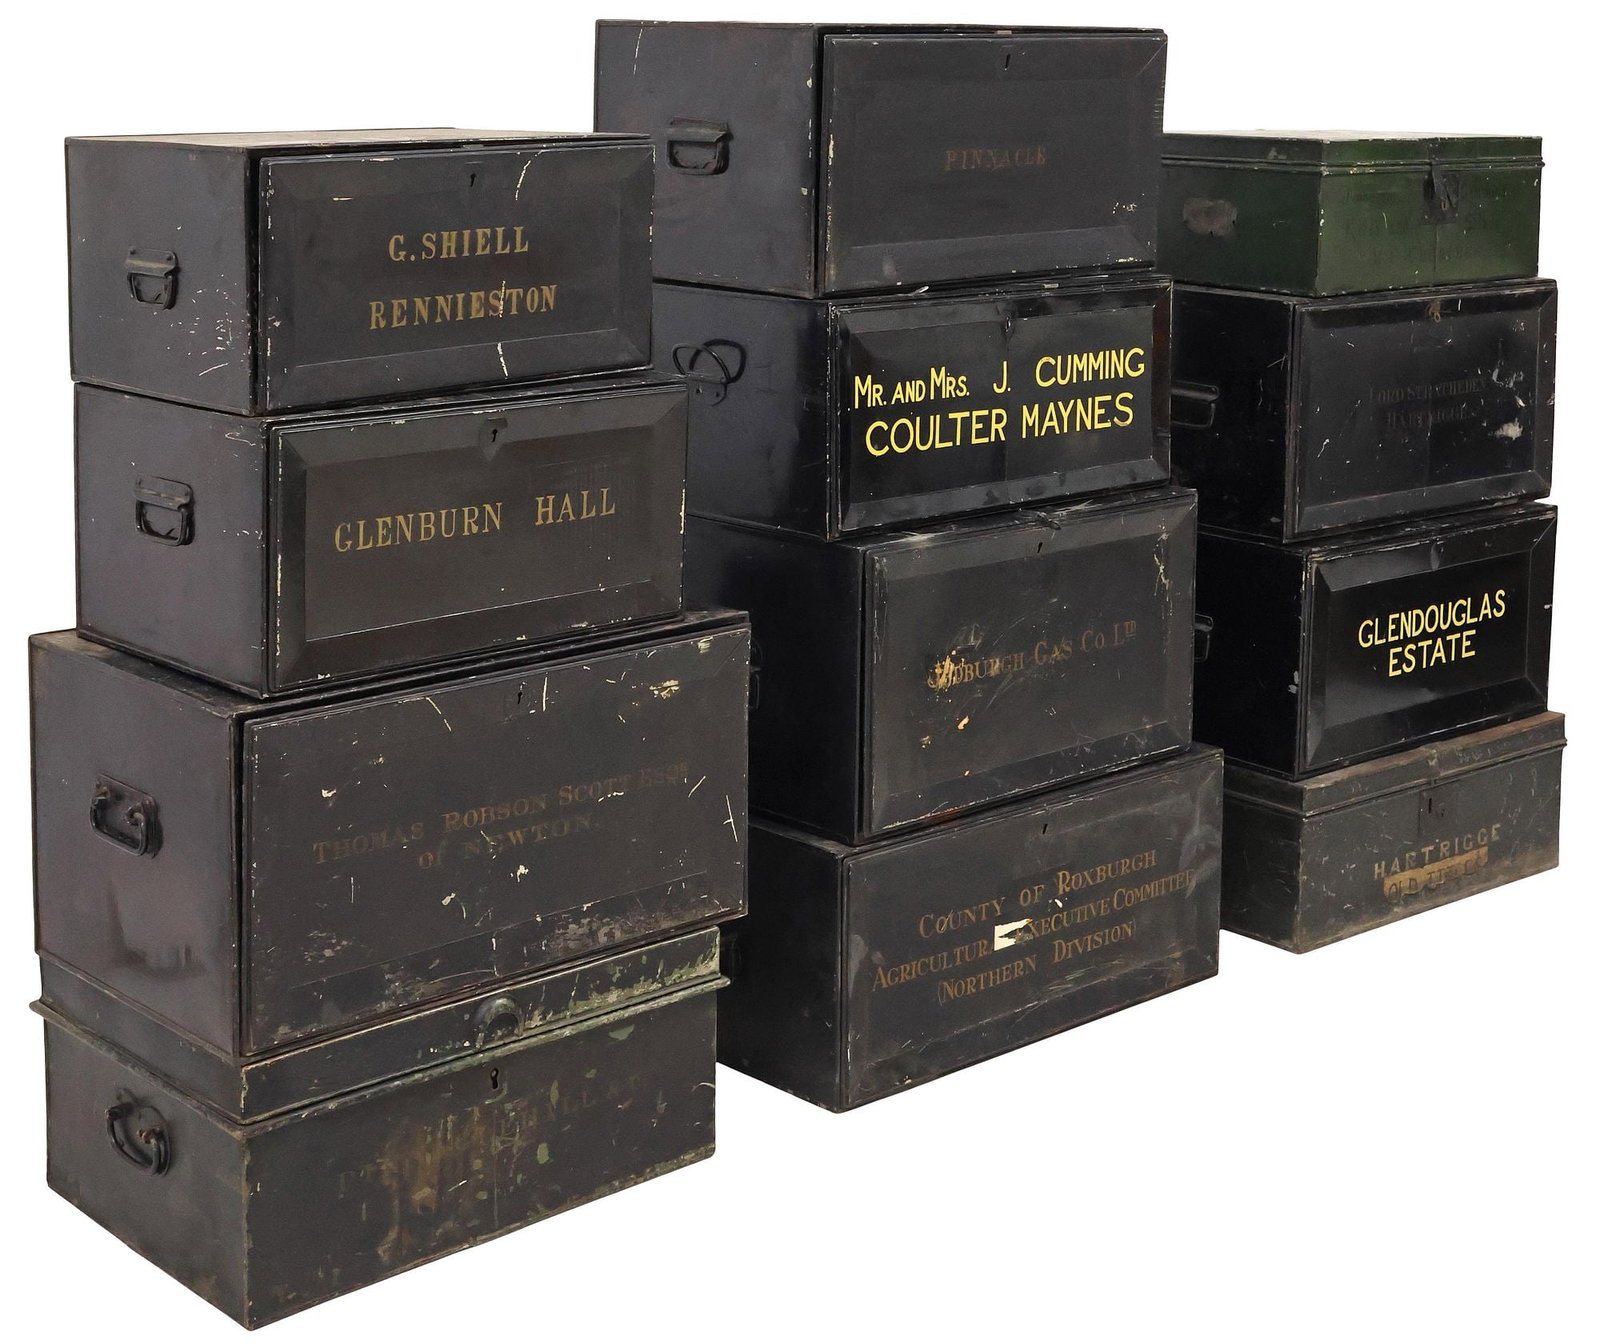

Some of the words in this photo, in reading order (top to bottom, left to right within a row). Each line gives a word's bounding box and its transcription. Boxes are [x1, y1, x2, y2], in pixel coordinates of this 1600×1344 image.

[369, 284, 557, 330] RENNIESTON
[891, 379, 926, 404] AND
[992, 360, 1011, 394] J.
[1035, 347, 1145, 388] CUMMING
[865, 408, 1008, 458] COULTER
[1021, 391, 1135, 439] MAYNES
[334, 502, 503, 552] GLENBURN
[535, 487, 616, 526] HALL
[1358, 589, 1506, 648] GLENDOUGLAS
[1034, 640, 1073, 666] GAS
[1388, 629, 1477, 678] ESTATE
[312, 821, 424, 865] THOMAS
[441, 793, 548, 833] ROBSON
[1374, 823, 1501, 880] HARTRIGGE
[919, 897, 1006, 938] COUNTY
[1019, 884, 1045, 908] OF
[1057, 850, 1157, 895] ROXBURGH
[1113, 869, 1196, 912] COMMITTEE
[937, 954, 1038, 1007] (NORTHERN
